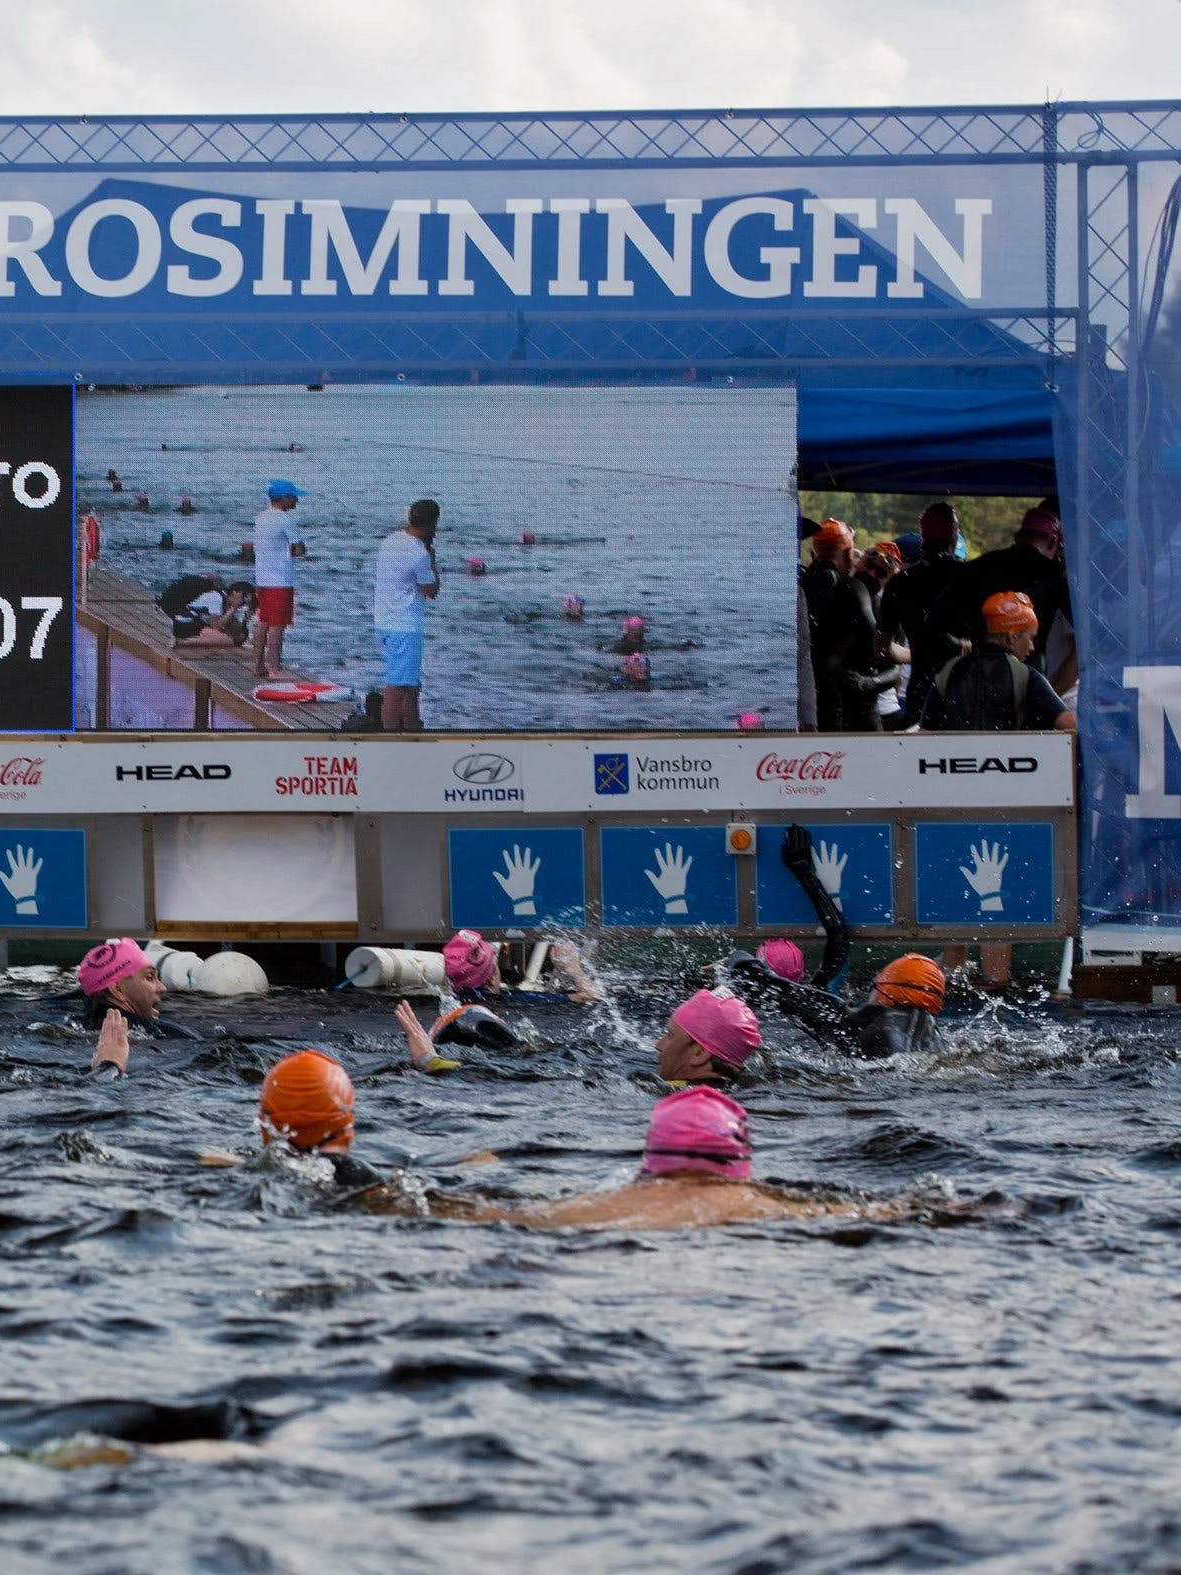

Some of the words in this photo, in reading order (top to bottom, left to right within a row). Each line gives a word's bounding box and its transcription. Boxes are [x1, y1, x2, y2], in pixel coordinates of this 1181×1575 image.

[115, 764, 232, 781] HEAD
[304, 757, 359, 776] TEAM
[635, 755, 712, 773] Vansbro
[919, 757, 1039, 774] HEAD
[275, 776, 359, 796] SPORTIA
[636, 773, 720, 790] kommun
[444, 788, 524, 802] HYUNDAI
[785, 785, 827, 797] Sverige
